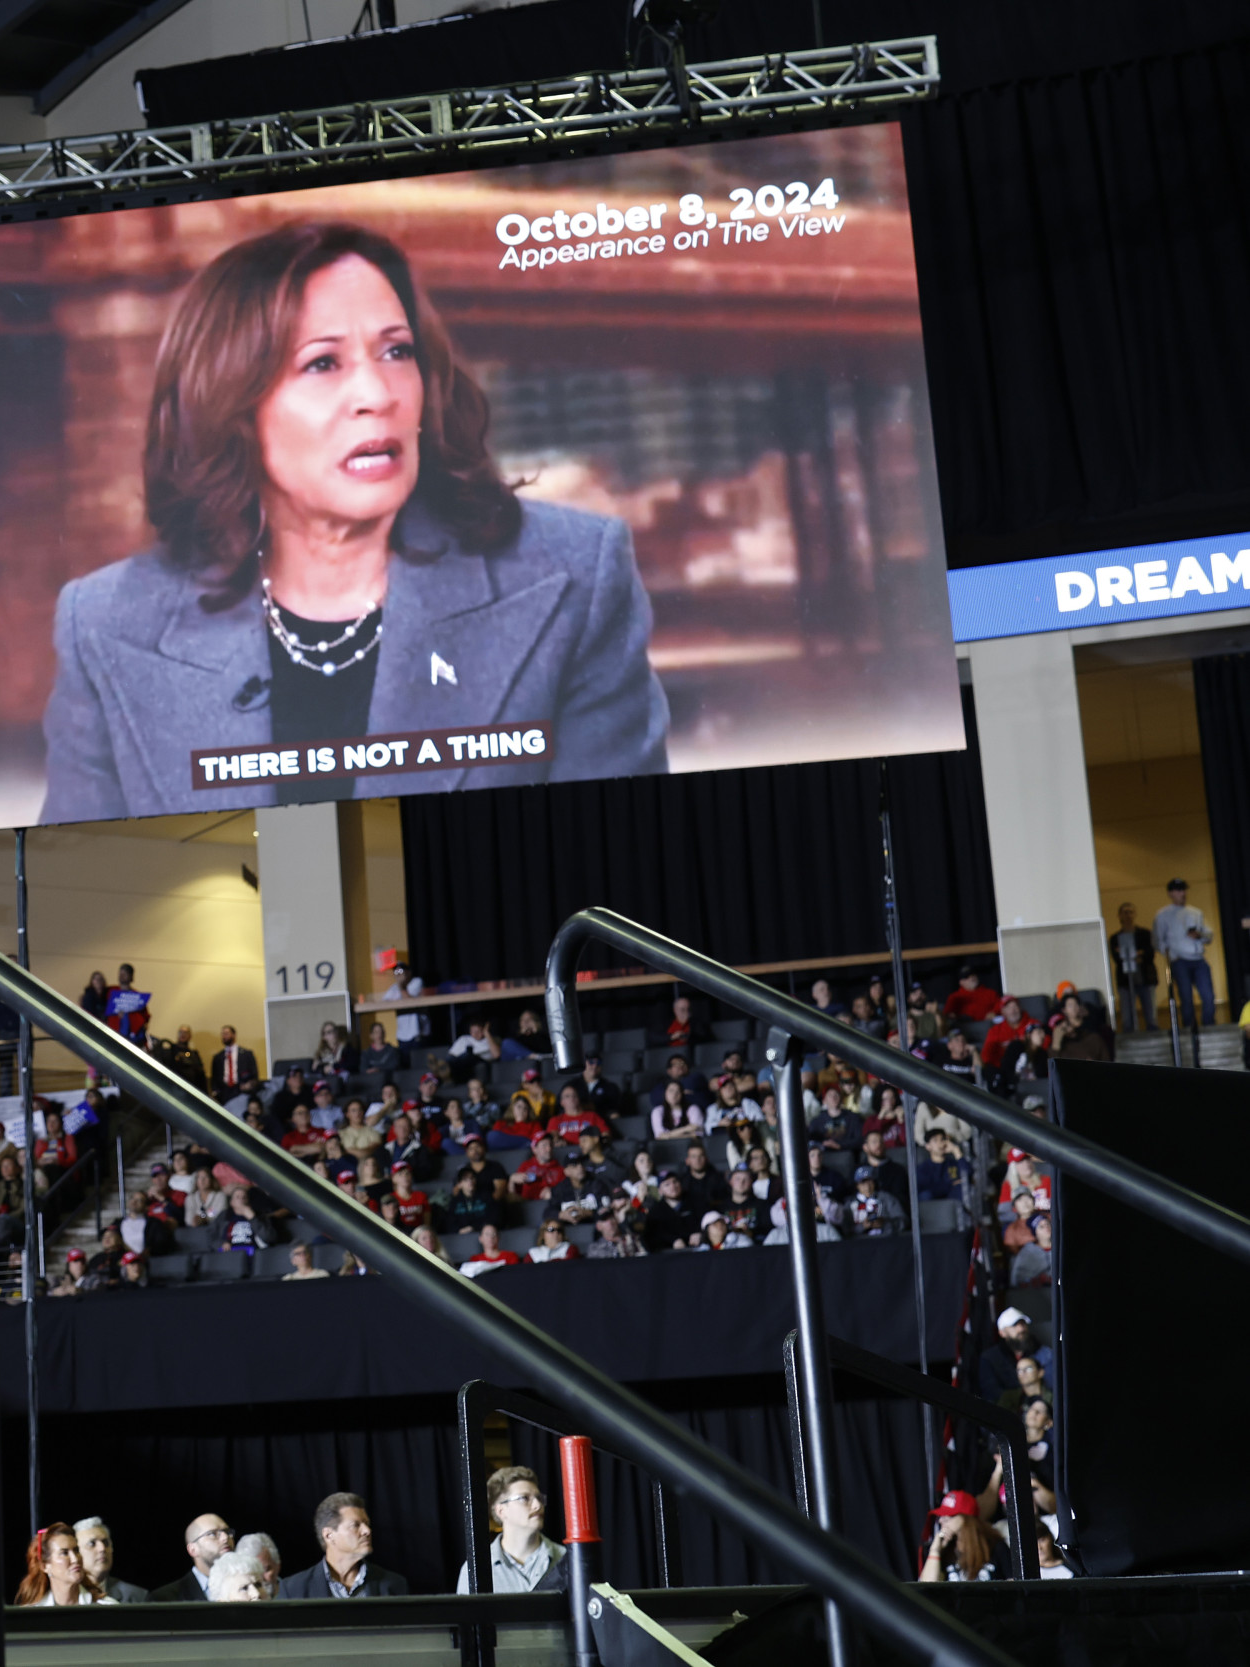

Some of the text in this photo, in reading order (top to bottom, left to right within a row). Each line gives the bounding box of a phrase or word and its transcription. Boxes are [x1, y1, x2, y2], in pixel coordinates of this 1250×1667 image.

[495, 178, 840, 246] October 8, 2024
[498, 214, 846, 271] Appearance on The View
[1054, 549, 1250, 613] DREAM
[198, 729, 546, 782] THERE IS NOT A THING
[275, 961, 335, 994] 119
